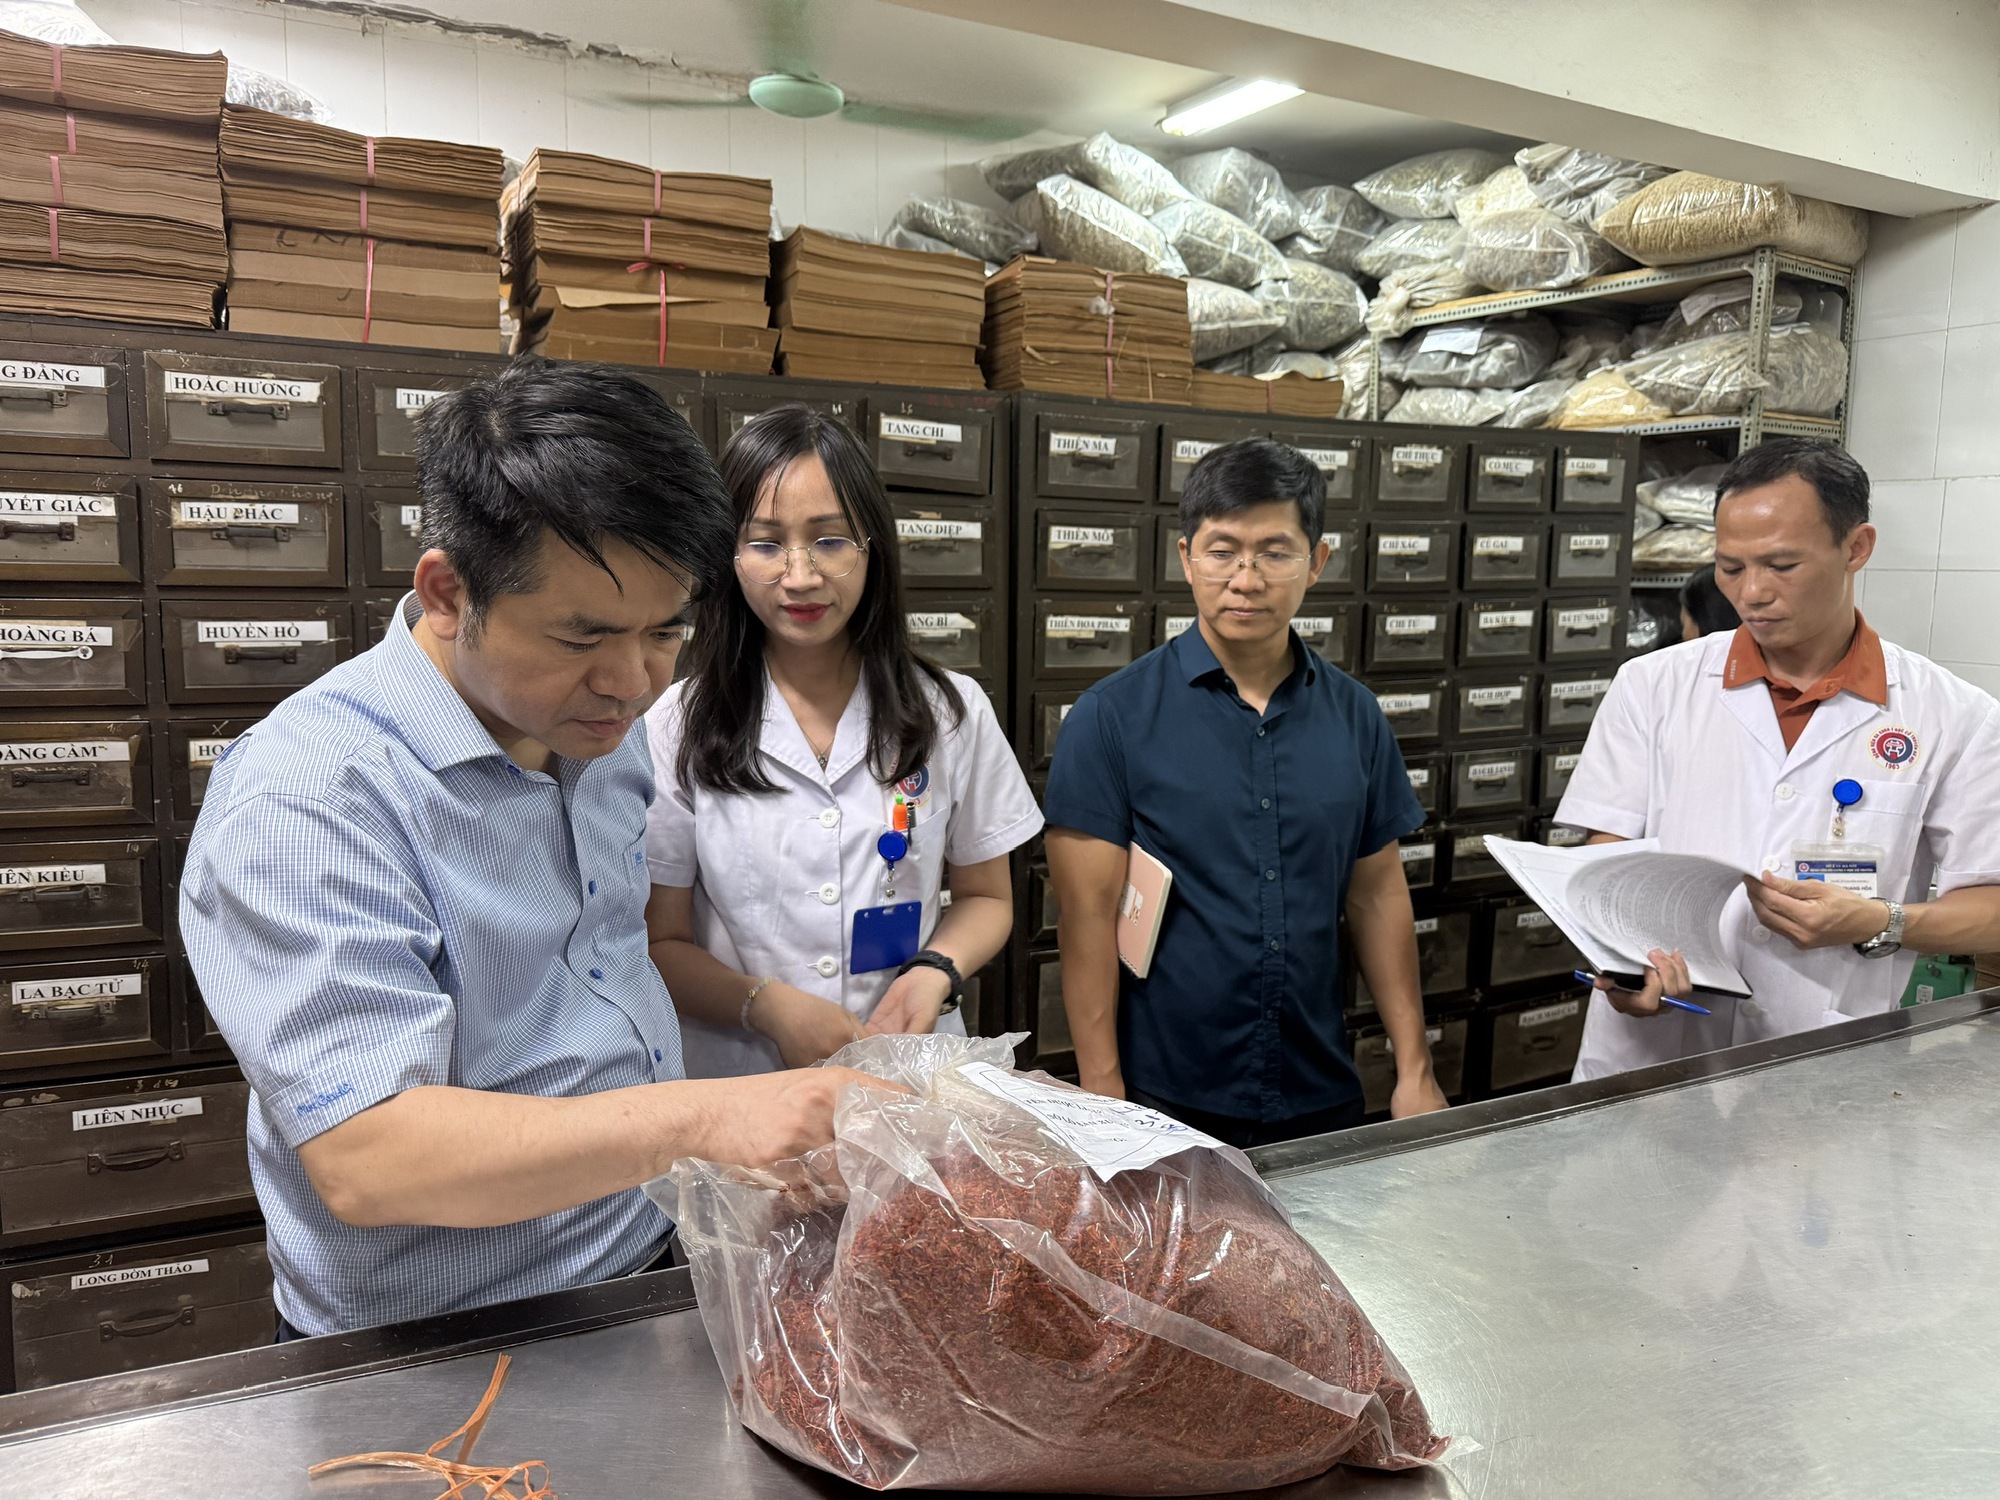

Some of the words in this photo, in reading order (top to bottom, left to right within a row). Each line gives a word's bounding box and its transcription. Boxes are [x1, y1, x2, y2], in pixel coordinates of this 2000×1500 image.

[234, 379, 301, 398] HƯƠNG
[886, 422, 920, 436] TANG
[922, 425, 944, 438] CHI
[51, 497, 102, 513] GIÁC
[188, 504, 227, 522] HẬU
[900, 523, 933, 535] TANG
[909, 616, 932, 627] ANG
[72, 627, 98, 643] BÁ
[20, 988, 46, 1000] LA
[52, 984, 91, 1000] BẠC
[95, 978, 124, 994] TỬ
[82, 1110, 126, 1127] LIÊN
[131, 1103, 184, 1121] NHỤC
[78, 1272, 117, 1287] LONG
[155, 1262, 193, 1276] THẢO
